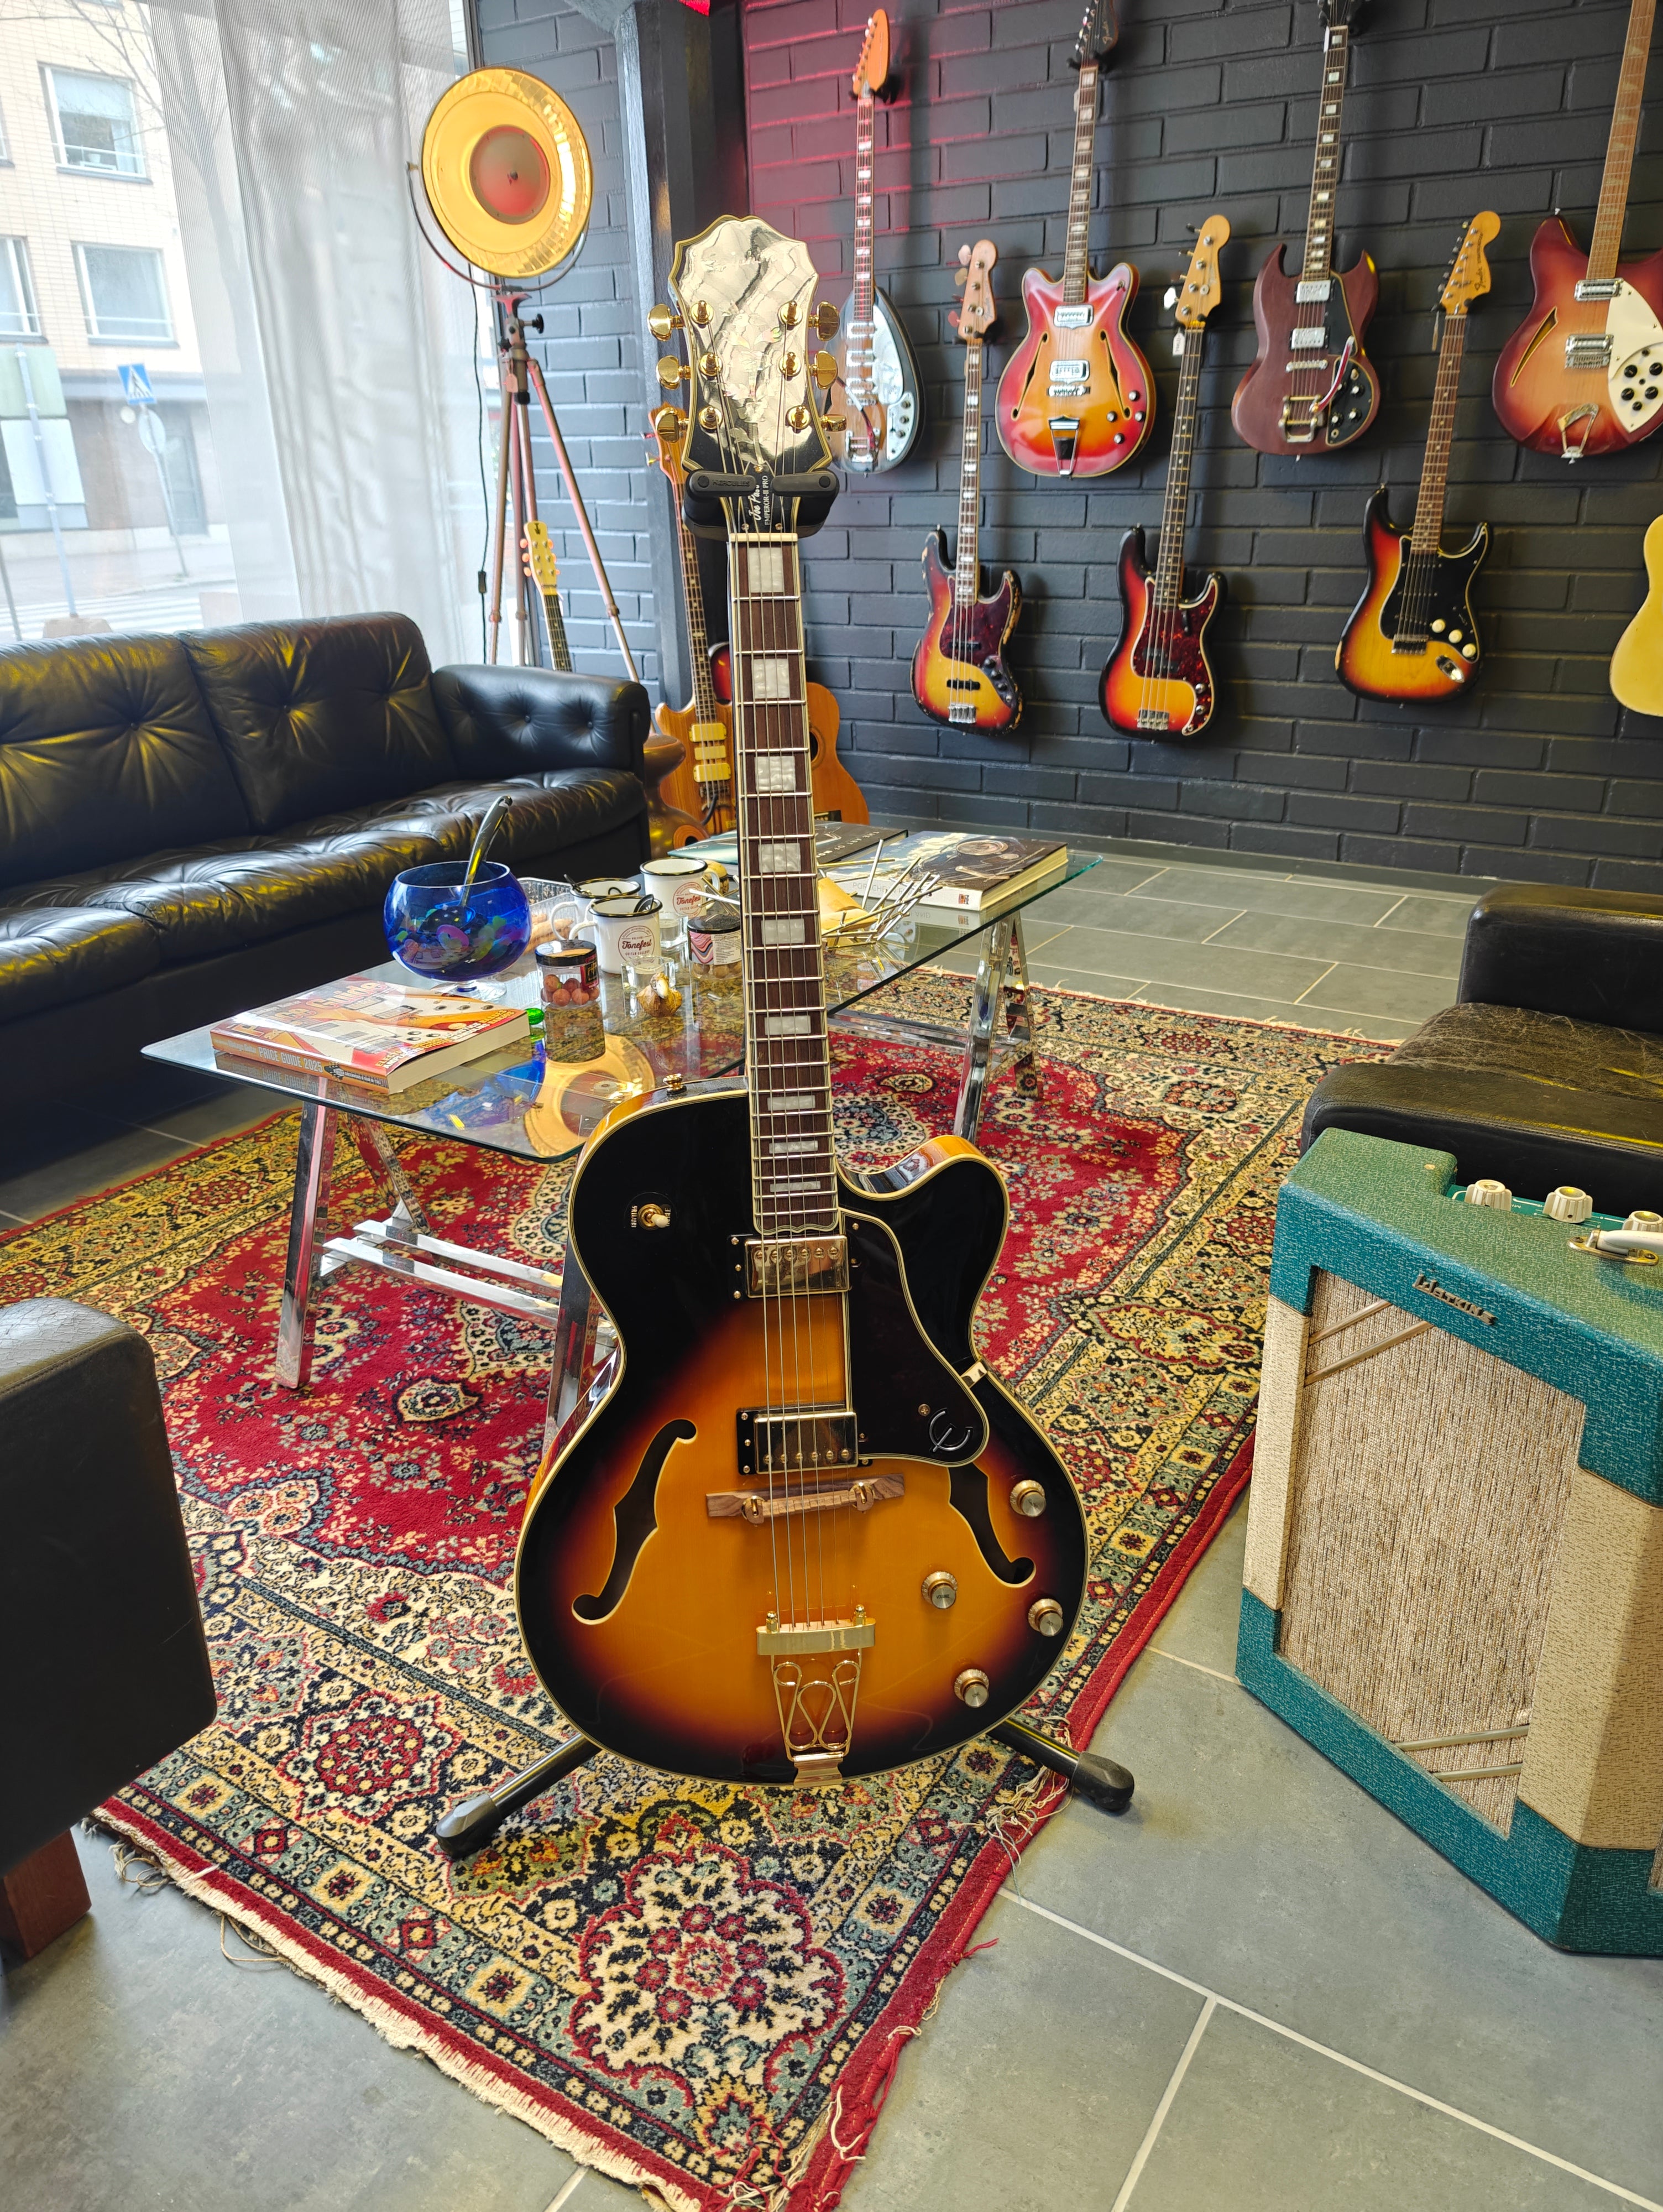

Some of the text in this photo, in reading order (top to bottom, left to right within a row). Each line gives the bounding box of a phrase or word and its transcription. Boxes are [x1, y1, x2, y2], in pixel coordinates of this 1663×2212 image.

[712, 479, 750, 487] HERCULES
[749, 504, 761, 520] Joe
[622, 939, 652, 951] Tonefest
[258, 1046, 280, 1062] PRICE
[280, 1052, 302, 1068] GUIDE
[304, 1057, 323, 1074] 2025
